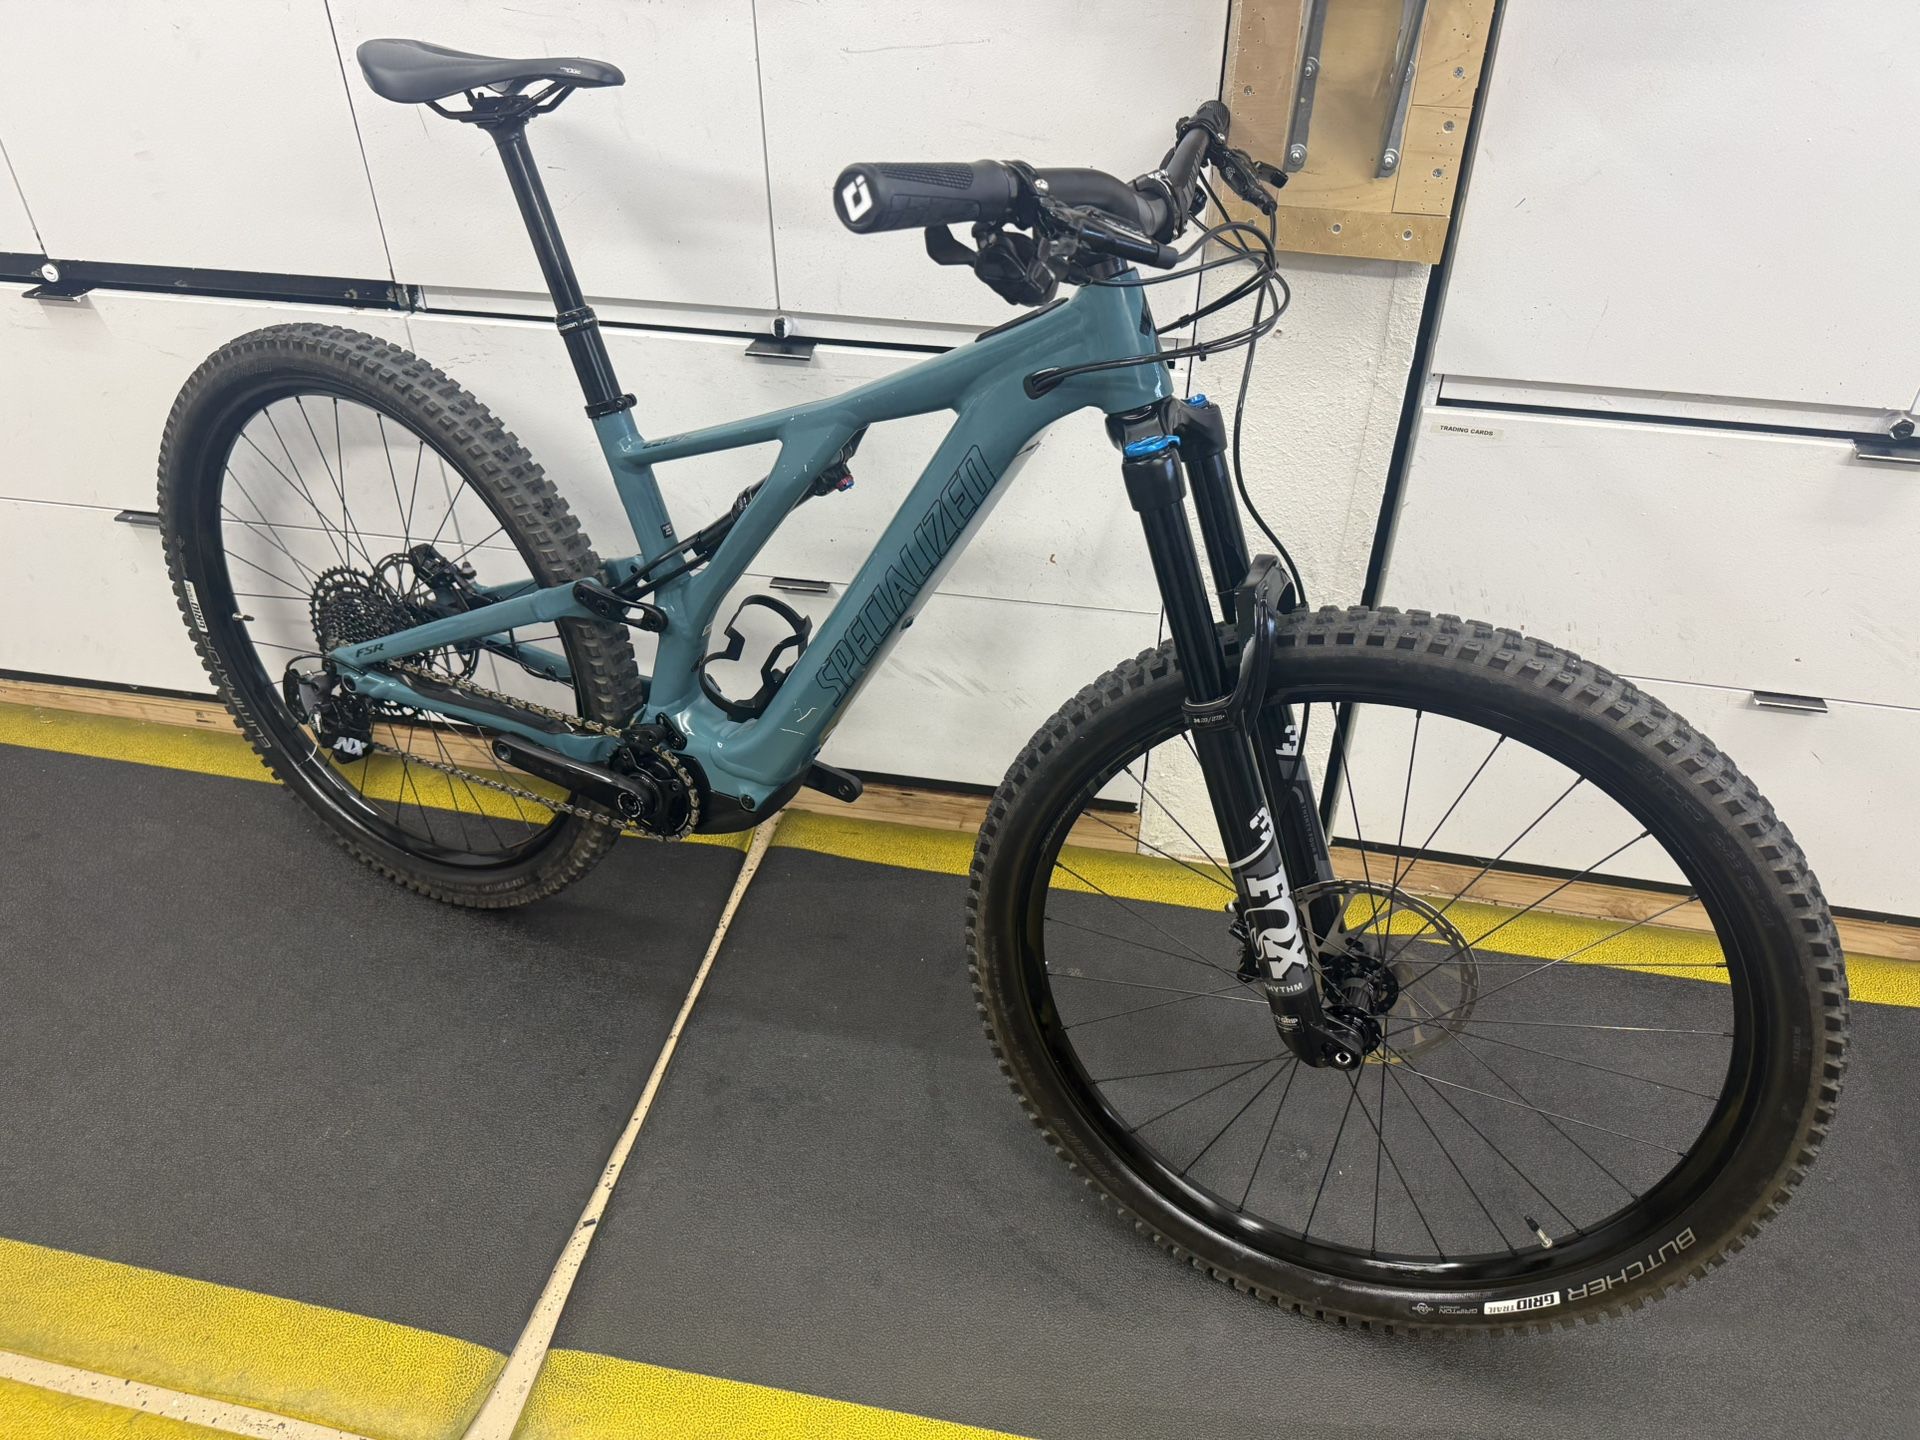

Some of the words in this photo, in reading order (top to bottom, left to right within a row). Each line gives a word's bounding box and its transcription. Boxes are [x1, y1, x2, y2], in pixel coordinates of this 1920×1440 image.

[1440, 425, 1469, 433] TRADING
[816, 444, 997, 707] SPECIALIZED
[355, 642, 385, 658] FSR
[201, 634, 272, 749] ELIMINATOR
[332, 736, 368, 757] NX
[1244, 862, 1310, 980] FOX
[1567, 1226, 1698, 1302] BUTCHER
[1488, 1304, 1515, 1314] TRAIL
[1516, 1293, 1555, 1311] GRID
